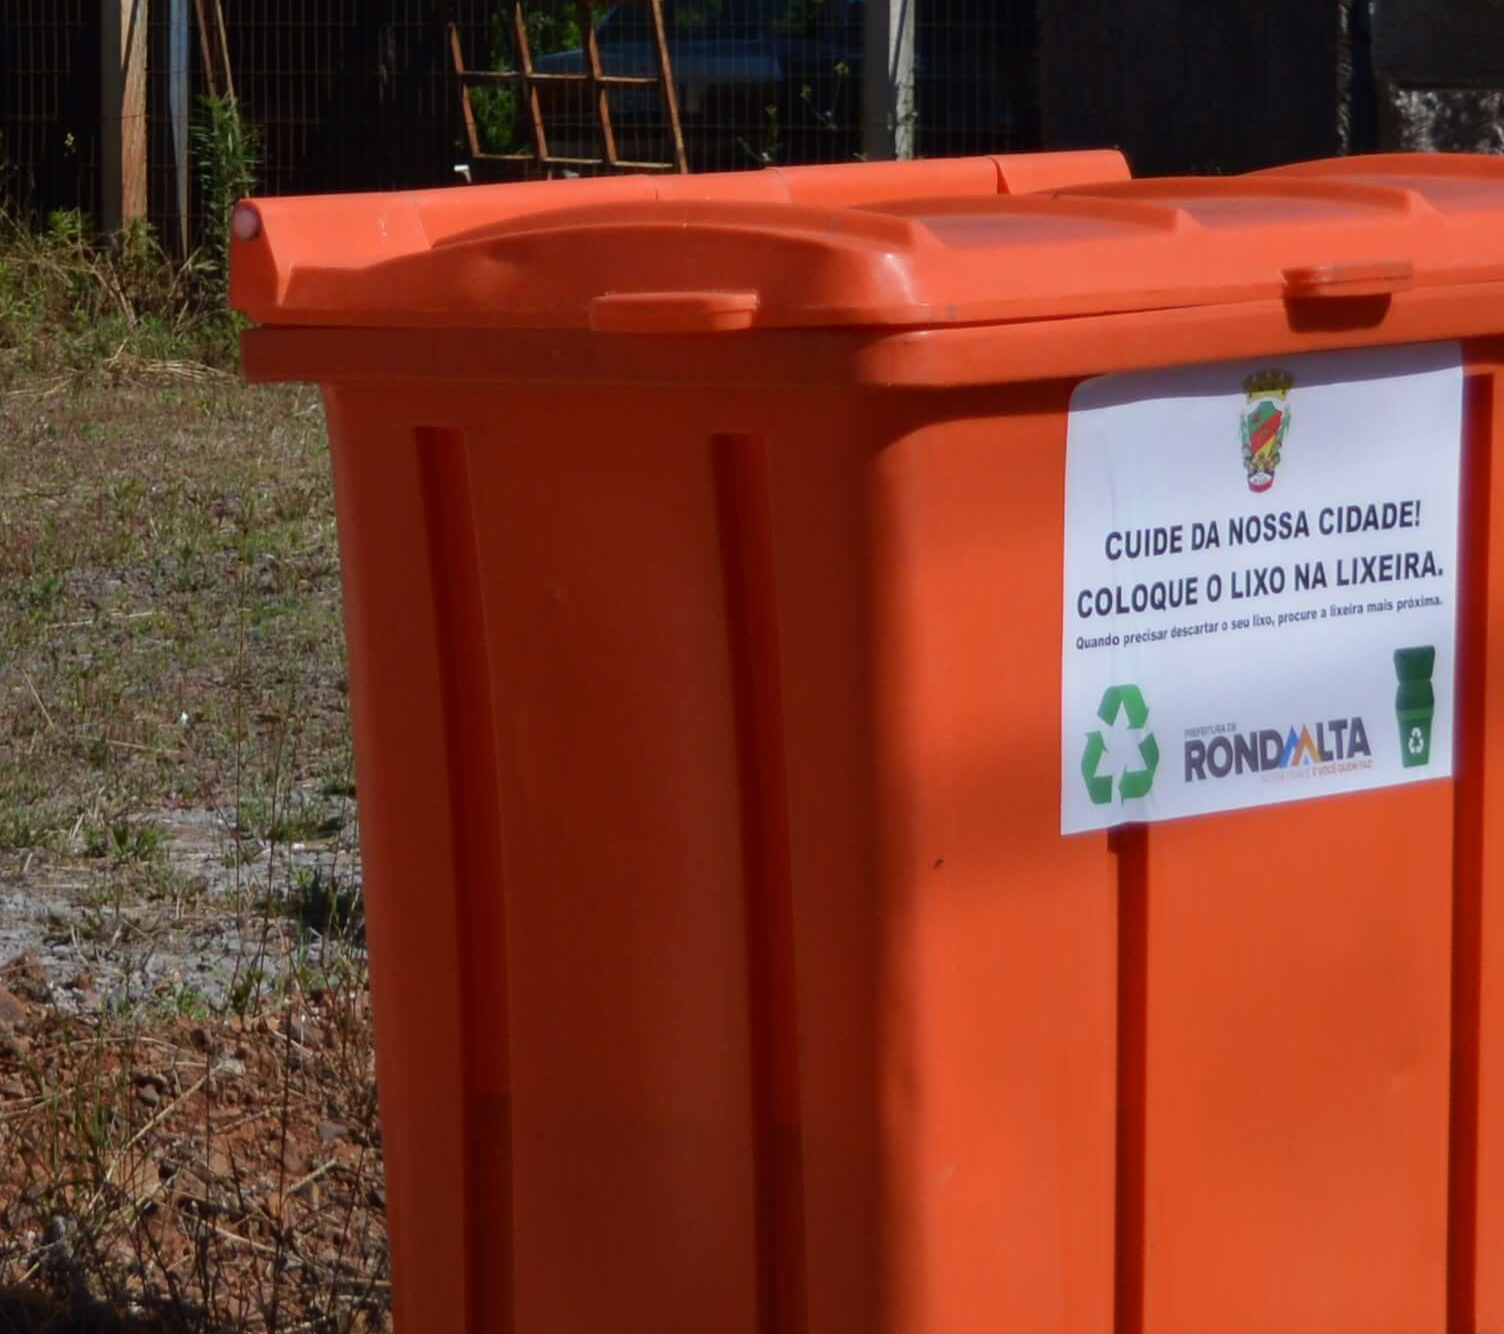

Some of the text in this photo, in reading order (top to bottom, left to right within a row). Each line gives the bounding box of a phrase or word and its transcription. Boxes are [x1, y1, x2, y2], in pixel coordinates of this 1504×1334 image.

[1104, 499, 1422, 560] CUIDE DA NOSSA CIDADE!
[1077, 550, 1444, 618] COLOQUE O LIXO NA LIXEIRA.
[1075, 594, 1444, 650] Quando precisar descartar o seu lixo, procure a lixeira mais próxima.
